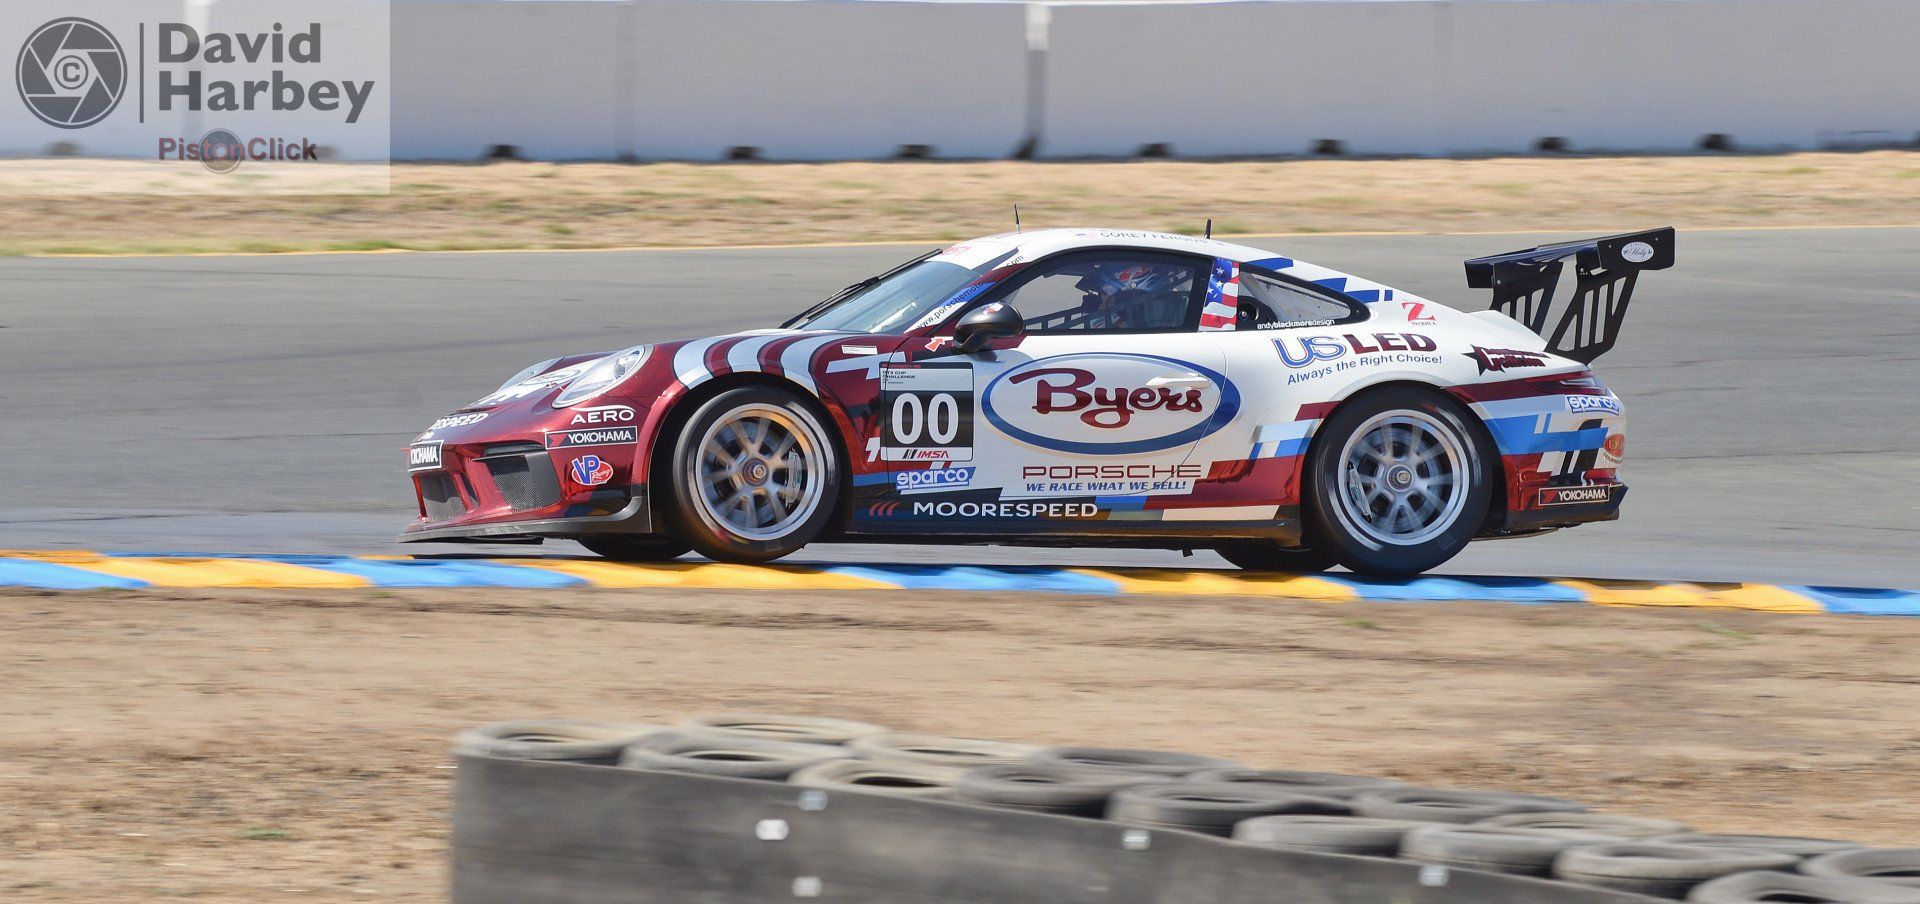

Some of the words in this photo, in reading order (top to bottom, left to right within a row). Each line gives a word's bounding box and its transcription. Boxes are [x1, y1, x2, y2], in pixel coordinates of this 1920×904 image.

[1401, 301, 1437, 322] Z
[1257, 318, 1335, 330] andyblackmoredesign
[1271, 335, 1347, 369] US
[1342, 332, 1437, 355] LED
[1287, 366, 1332, 385] Always
[1336, 360, 1357, 372] the
[1360, 353, 1394, 367] Right
[1400, 353, 1442, 364] Choice!
[1008, 367, 1204, 429] Byers
[1568, 395, 1620, 412] sparco
[571, 409, 634, 425] AERO
[892, 392, 959, 445] 00
[568, 430, 632, 444] YOKOHAMA
[916, 450, 949, 459] IMSA
[572, 455, 600, 485] VP
[1022, 464, 1202, 479] PORSCHE
[896, 468, 969, 489] sparco
[1026, 483, 1046, 492] WE
[1049, 482, 1083, 491] RACE
[1087, 481, 1125, 491] WHAT
[1128, 481, 1148, 491] WE
[1152, 481, 1187, 490] SELL!
[1558, 488, 1607, 501] YOKOHAMA
[913, 502, 1099, 517] MOORESPEED
